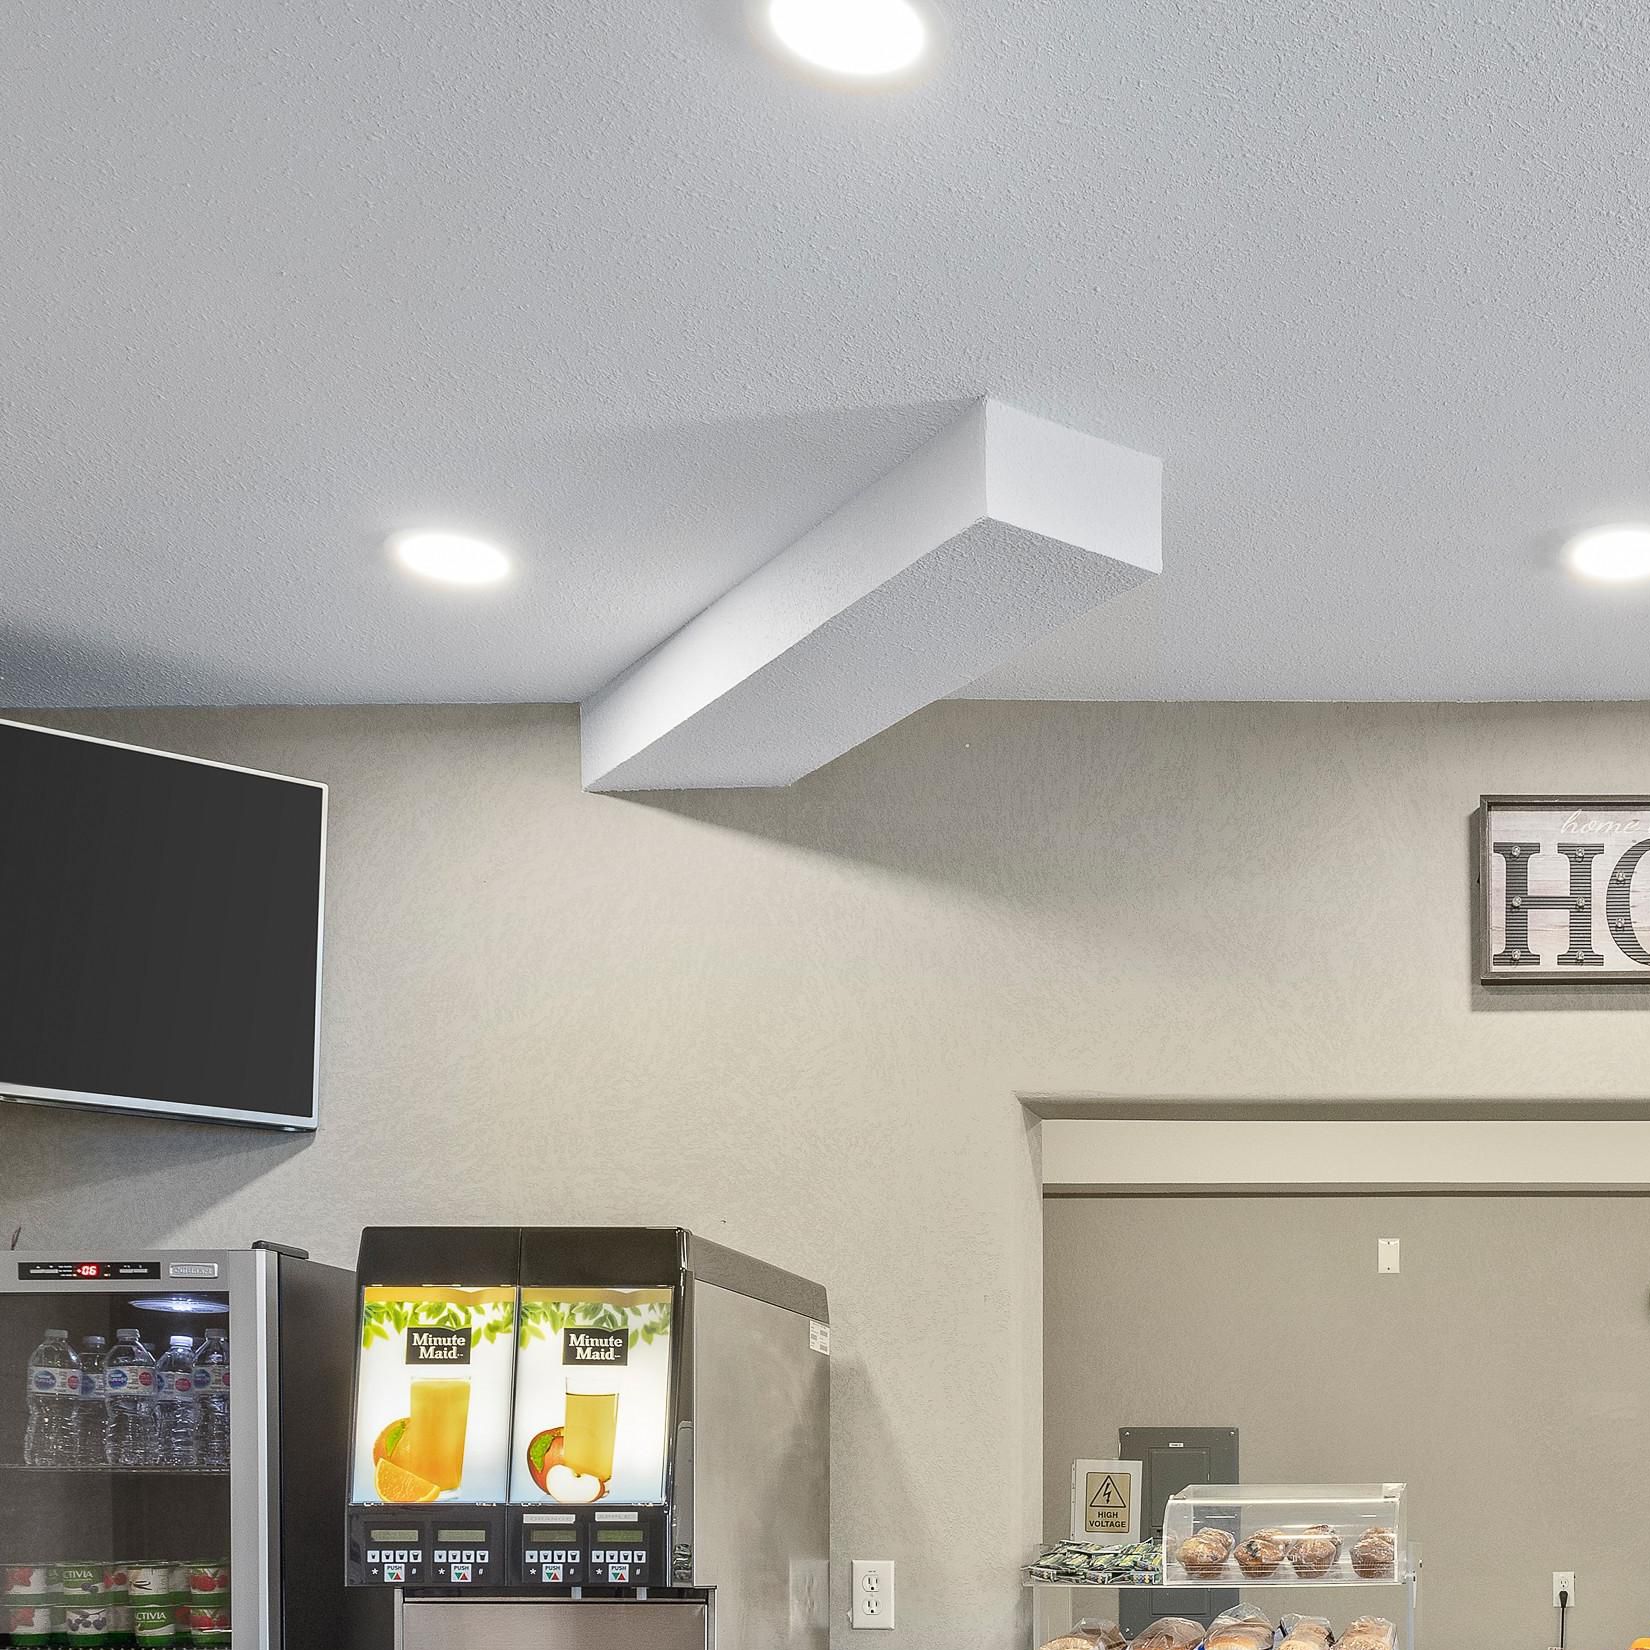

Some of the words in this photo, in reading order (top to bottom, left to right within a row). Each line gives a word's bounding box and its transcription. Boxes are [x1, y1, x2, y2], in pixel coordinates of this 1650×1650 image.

[1560, 809, 1640, 834] home
[412, 1332, 466, 1346] Minute
[568, 1333, 623, 1347] Minute
[419, 1346, 458, 1360] Maid
[575, 1347, 616, 1361] Maid
[1097, 1511, 1119, 1519] HIGH
[1089, 1520, 1127, 1528] VOLTAGE
[63, 1570, 94, 1578] CTIVIA
[135, 1612, 167, 1620] CTIVIA
